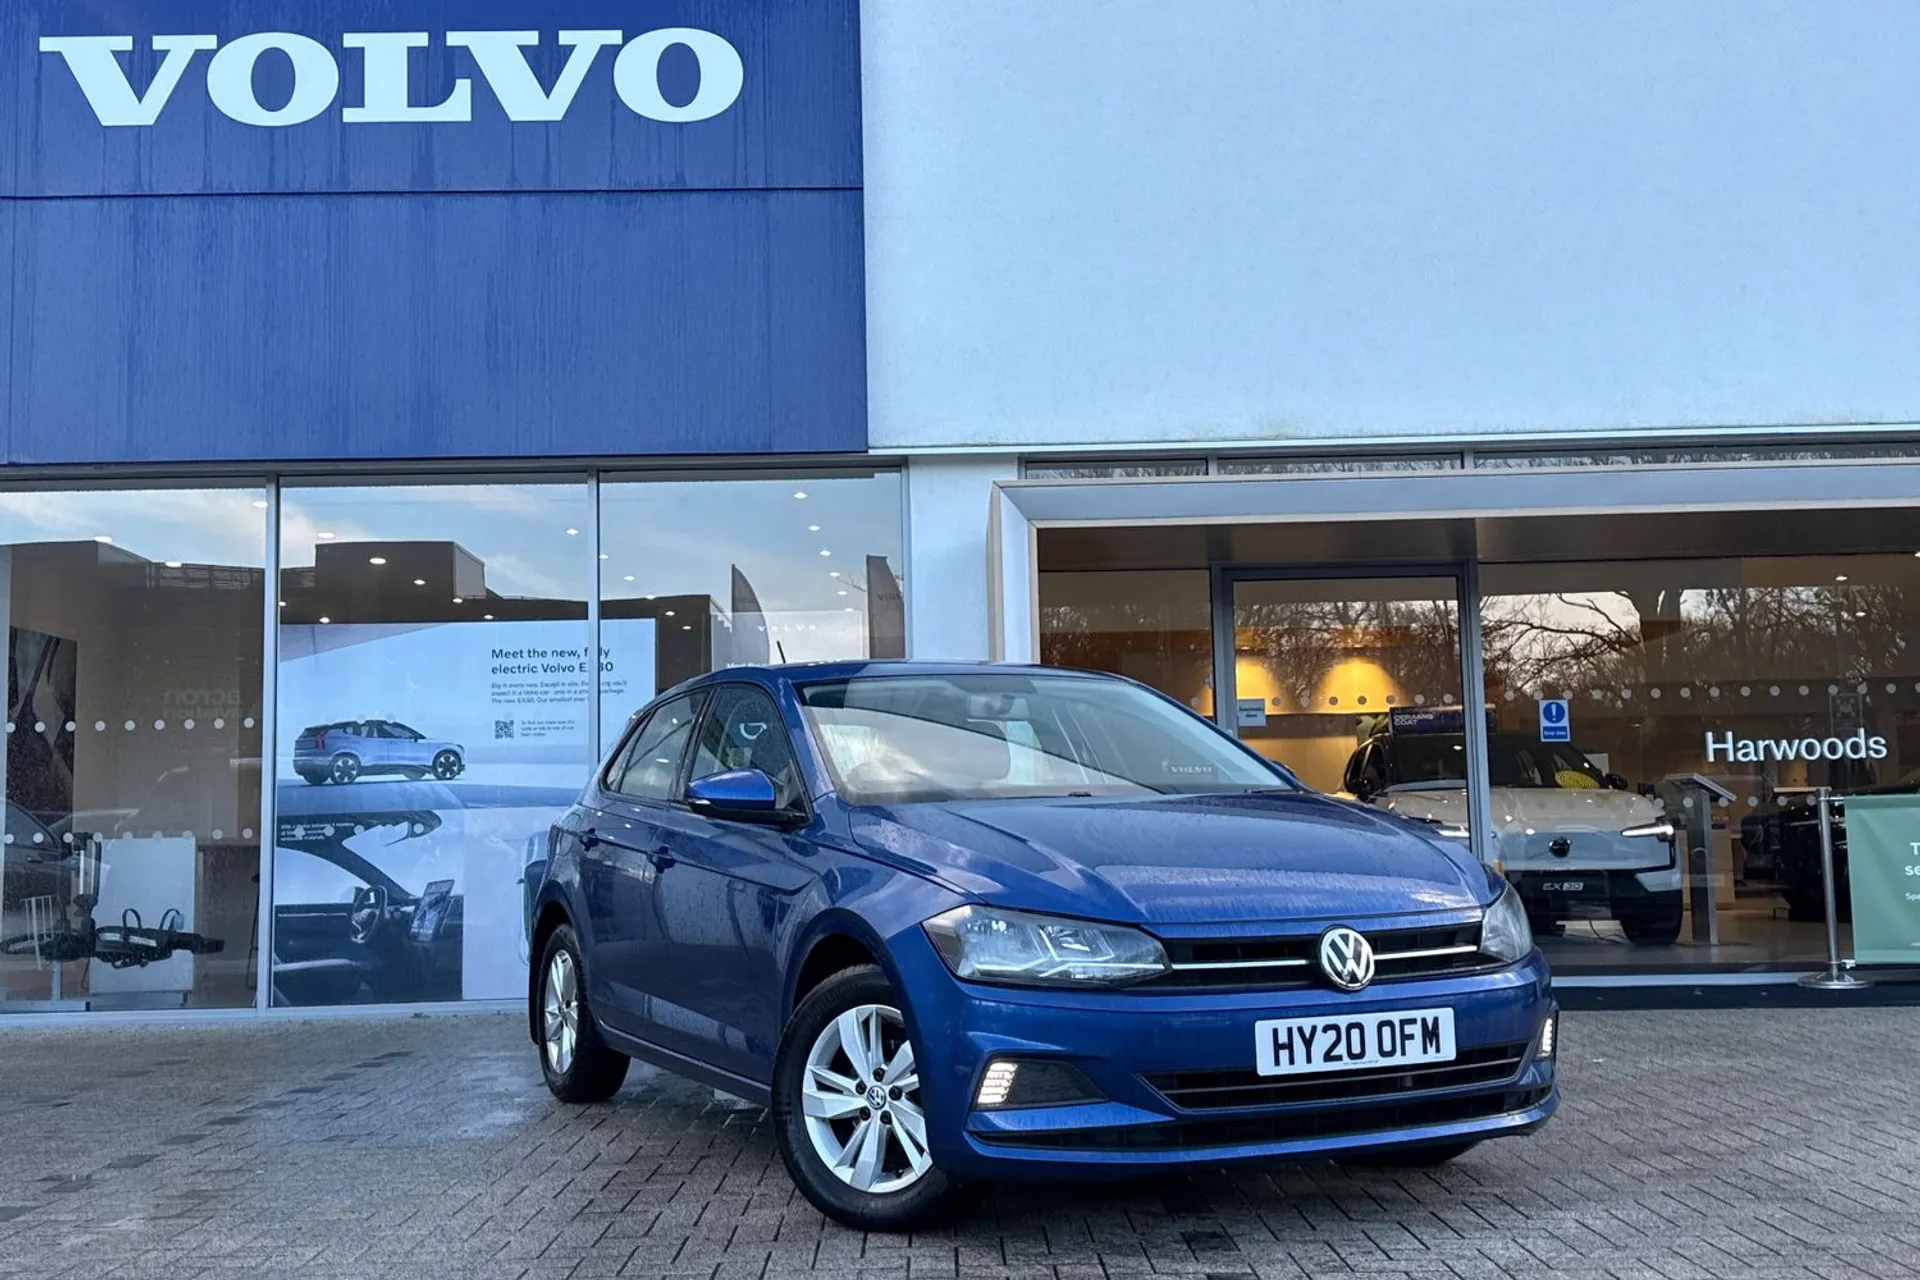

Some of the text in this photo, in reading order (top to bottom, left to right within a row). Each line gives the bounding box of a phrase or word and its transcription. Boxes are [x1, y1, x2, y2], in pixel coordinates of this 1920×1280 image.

[39, 27, 744, 127] VOLVO
[491, 648, 524, 659] Meet
[527, 648, 548, 658] the
[551, 649, 580, 659] new,
[491, 664, 538, 674] electric
[541, 662, 575, 673] Volvo
[1705, 727, 1888, 763] Harwoods
[1272, 1016, 1441, 1067] HY20 OFM
